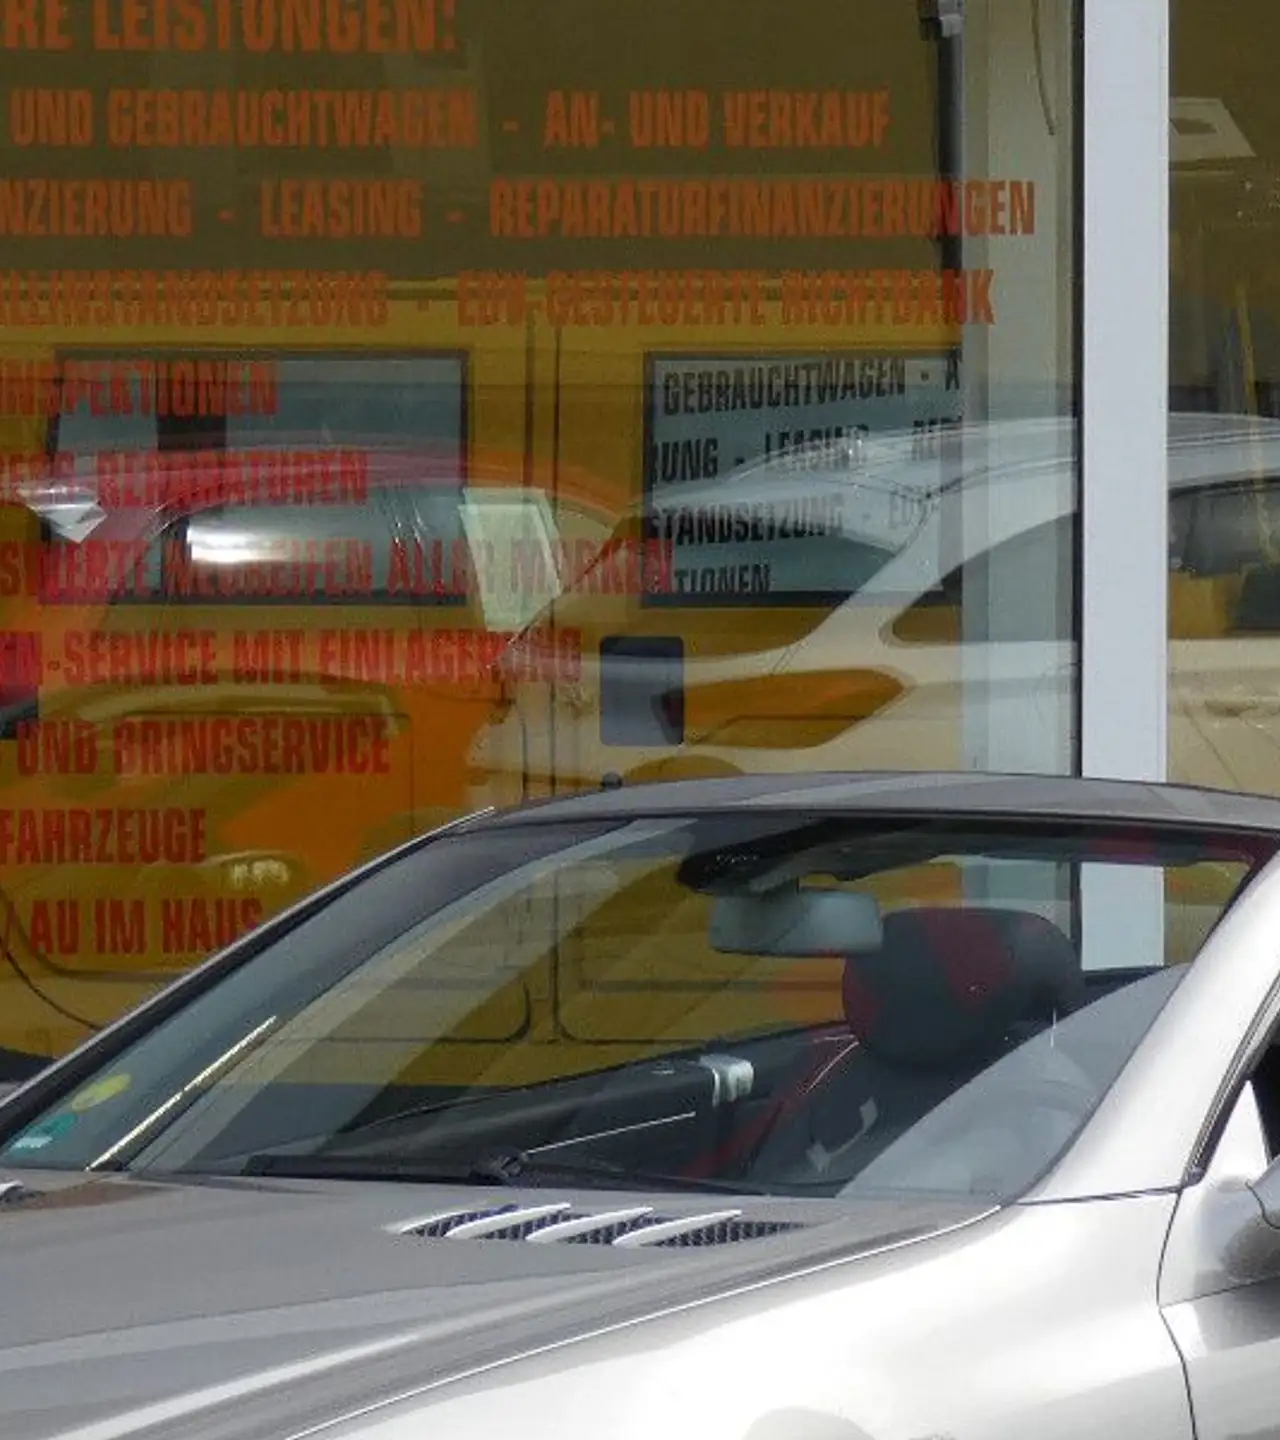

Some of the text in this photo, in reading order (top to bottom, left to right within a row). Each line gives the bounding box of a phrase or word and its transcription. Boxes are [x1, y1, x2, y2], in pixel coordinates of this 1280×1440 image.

[93, 0, 456, 53] LEISTUNGEN!
[10, 88, 93, 146] UND
[108, 89, 479, 147] GEBRAUCHTWAGEN
[543, 90, 614, 147] AN-
[630, 89, 709, 147] UND
[724, 86, 892, 148] VERKAUF
[261, 179, 423, 237] LEASING
[489, 179, 1036, 237] REPARATURFINANZIERUNGEN
[663, 356, 906, 416] GEBRAUCHTWAGEN
[231, 630, 303, 683] MIT
[17, 717, 98, 777] UND
[113, 716, 392, 775] BRINGSERVICE
[29, 898, 81, 956] AU
[94, 898, 148, 956] IM
